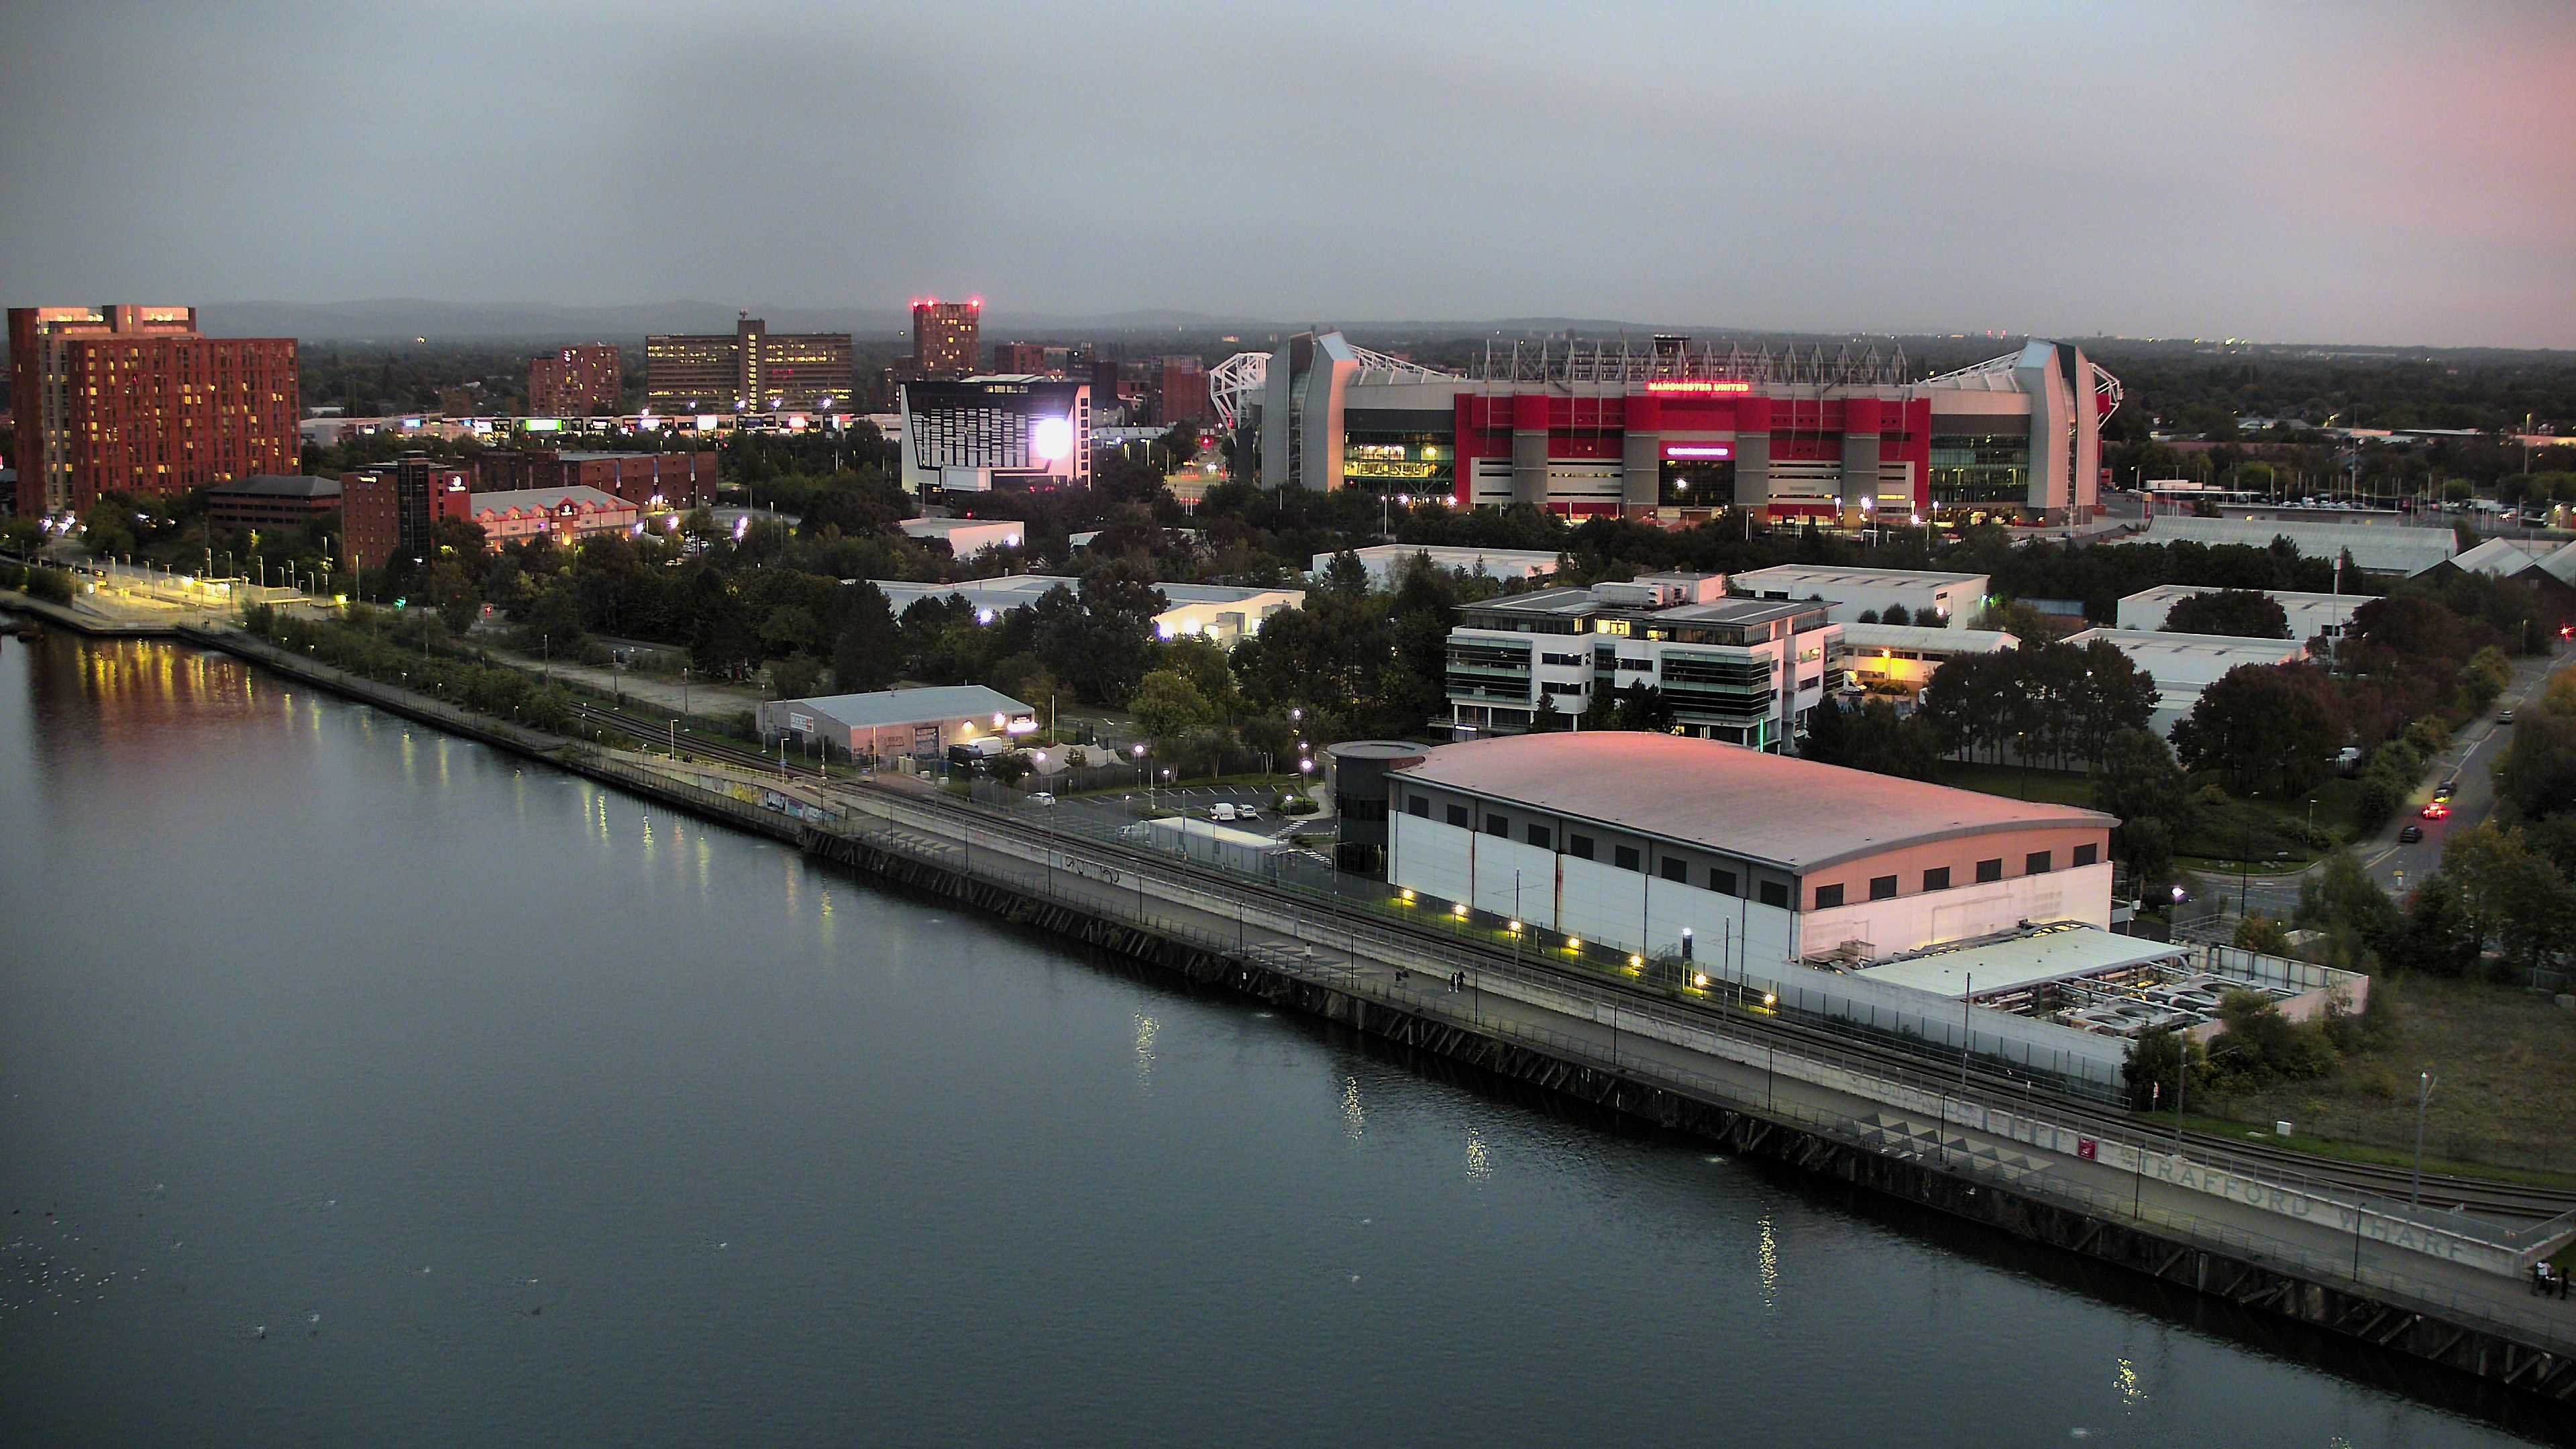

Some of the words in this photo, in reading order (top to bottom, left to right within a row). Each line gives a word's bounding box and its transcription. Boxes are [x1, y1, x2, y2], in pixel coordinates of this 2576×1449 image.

[1648, 382, 1712, 392] MANCHESTER
[1713, 382, 1750, 392] UNITED
[2139, 1148, 2311, 1217] TRAFFORD
[2339, 1210, 2465, 1258] WHARF
